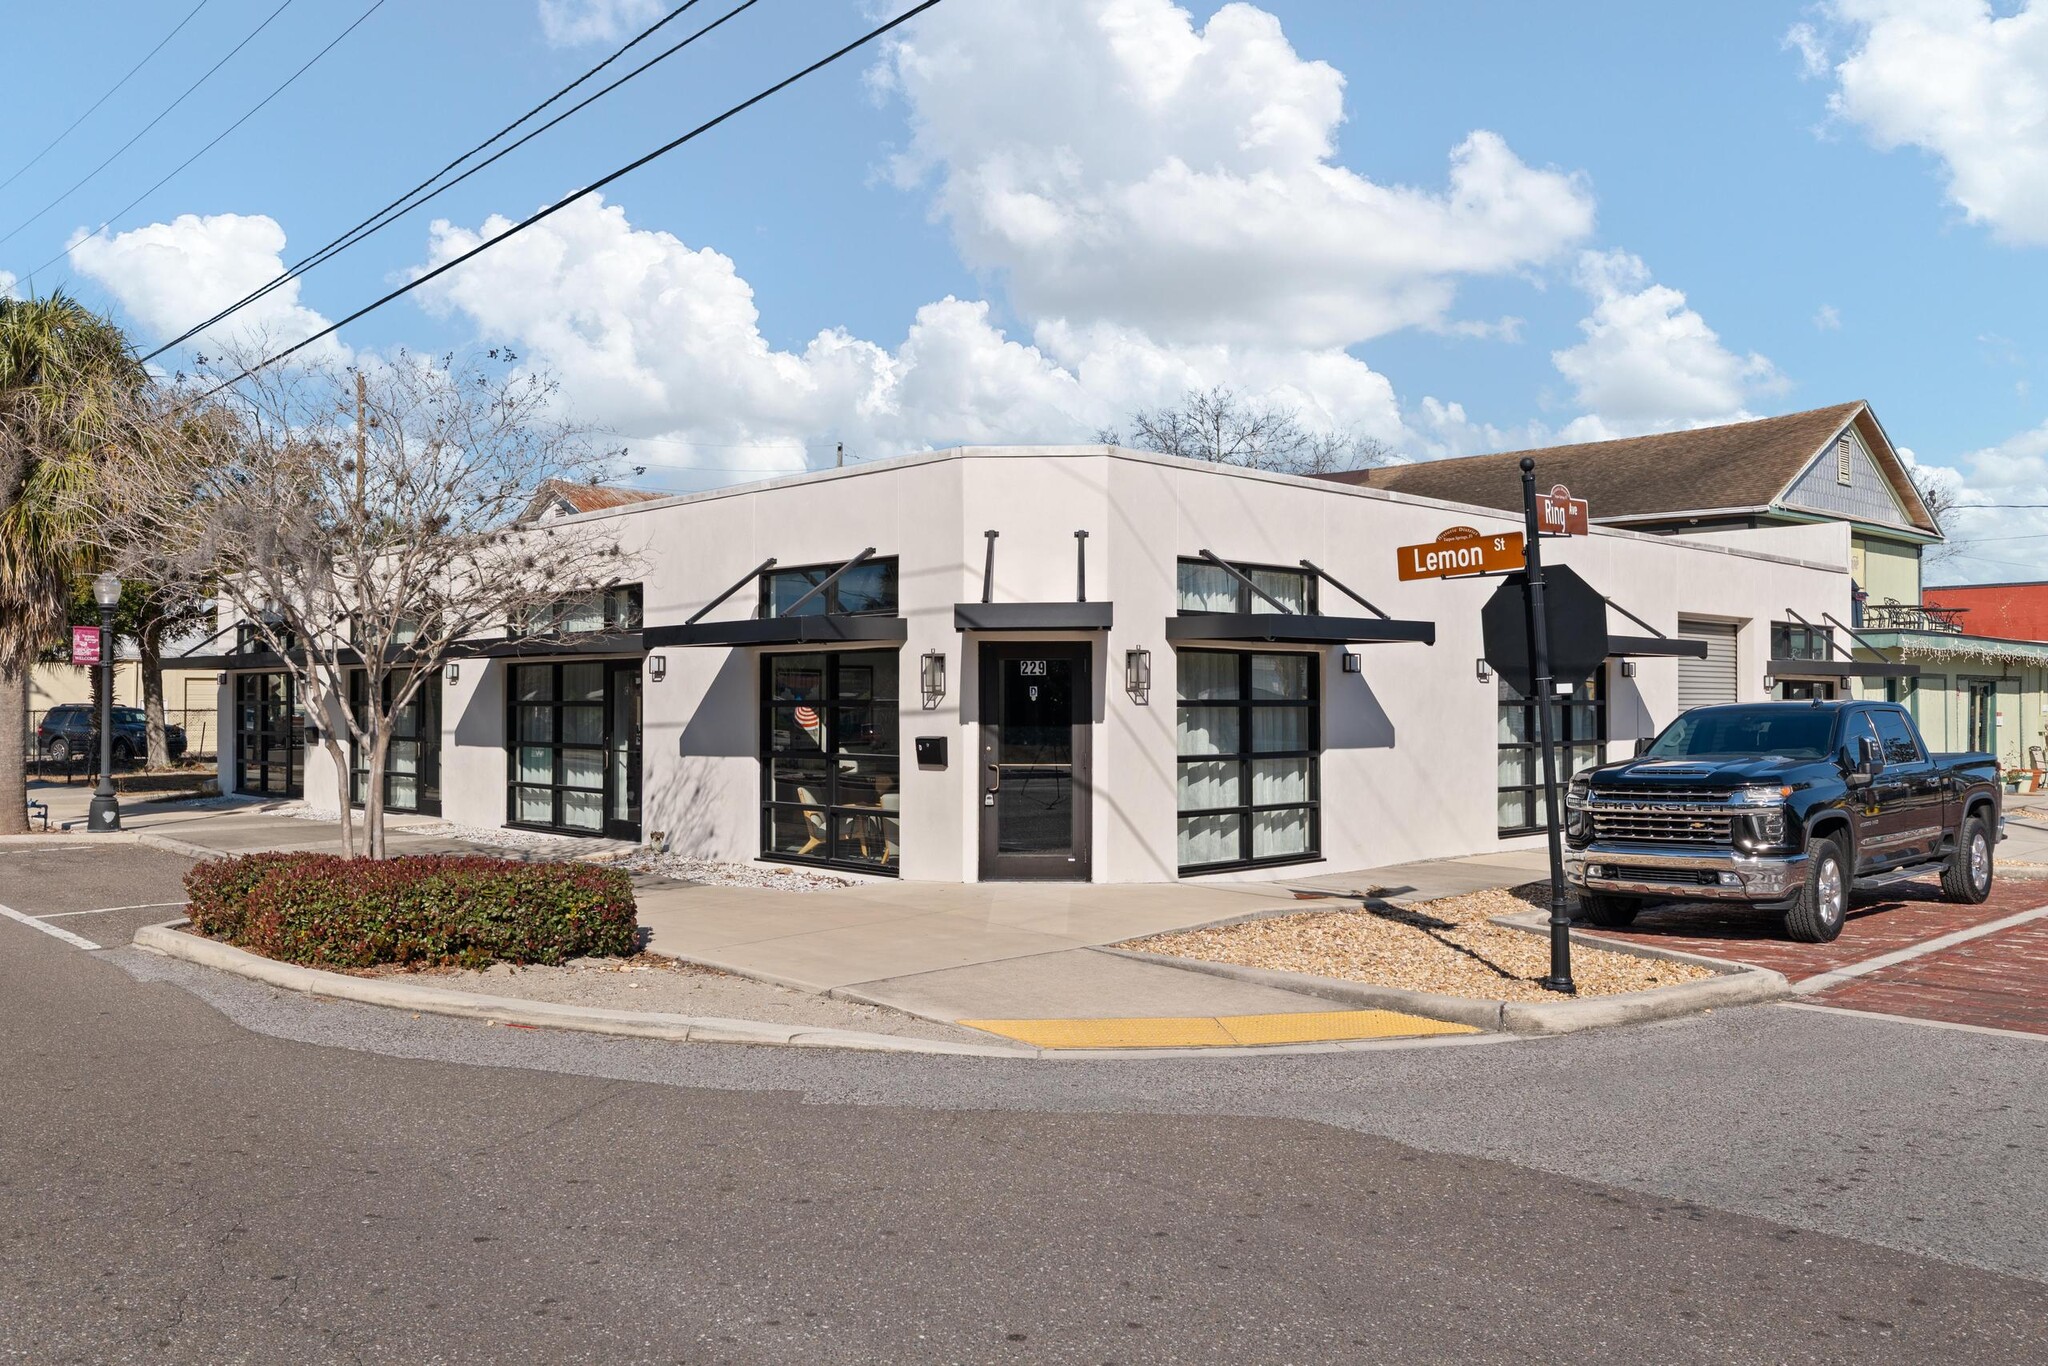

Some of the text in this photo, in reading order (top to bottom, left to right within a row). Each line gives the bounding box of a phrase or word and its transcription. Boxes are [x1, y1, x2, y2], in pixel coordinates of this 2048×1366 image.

[1545, 500, 1566, 533] Ring
[1414, 537, 1506, 573] Lemon St
[1021, 661, 1046, 675] 229
[1591, 801, 1724, 812] CHEVROLET
